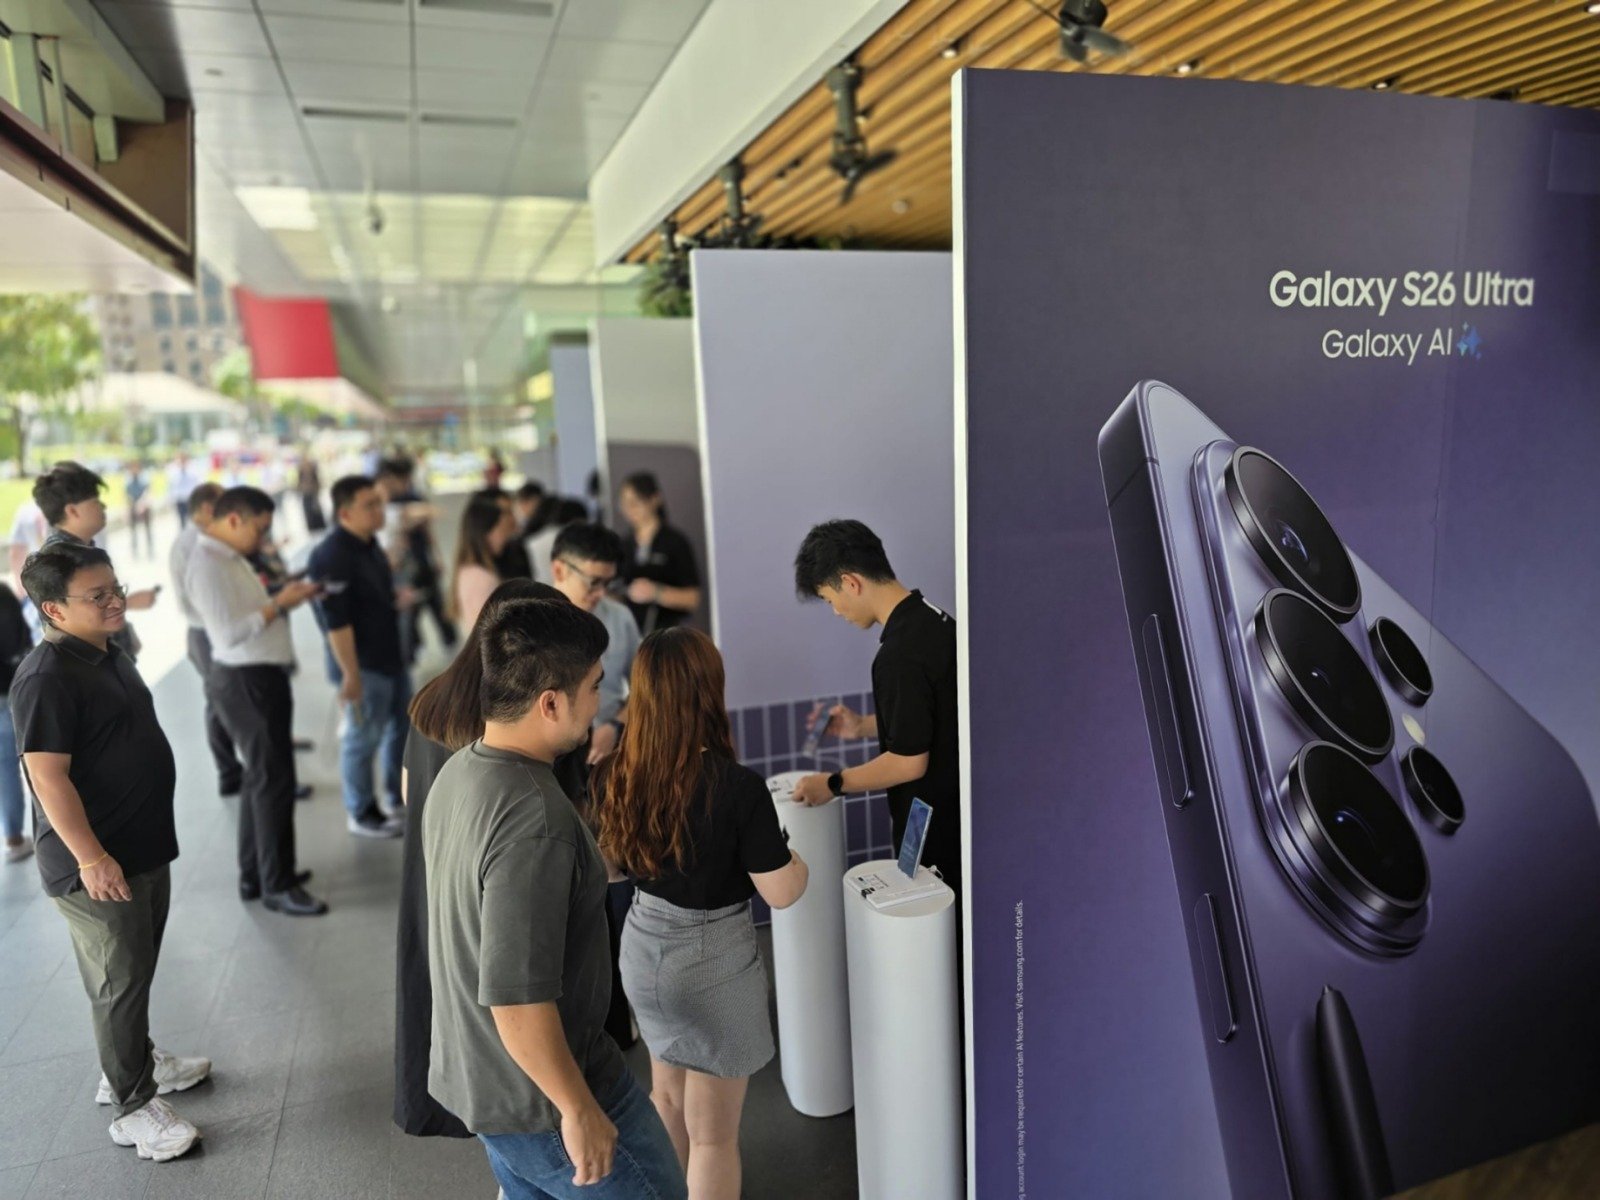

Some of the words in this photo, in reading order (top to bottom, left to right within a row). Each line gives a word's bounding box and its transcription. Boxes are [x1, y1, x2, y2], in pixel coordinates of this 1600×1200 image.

[1269, 270, 1398, 317] Galaxy
[1401, 271, 1457, 307] S26
[1463, 271, 1535, 307] Ultra
[1322, 328, 1423, 366] Galaxy
[1427, 328, 1453, 356] AI
[1014, 899, 1023, 928] details.
[1015, 929, 1023, 940] for
[1016, 940, 1025, 992] samsung.com
[1015, 991, 1024, 1010] Visit
[1016, 1009, 1024, 1042] features.
[1015, 1042, 1024, 1051] AI
[1016, 1052, 1024, 1077] certain
[1016, 1078, 1024, 1089] for
[1016, 1088, 1026, 1119] required
[1016, 1120, 1025, 1130] be
[1018, 1130, 1026, 1146] may
[1016, 1146, 1026, 1165] login
[1017, 1165, 1025, 1193] account
